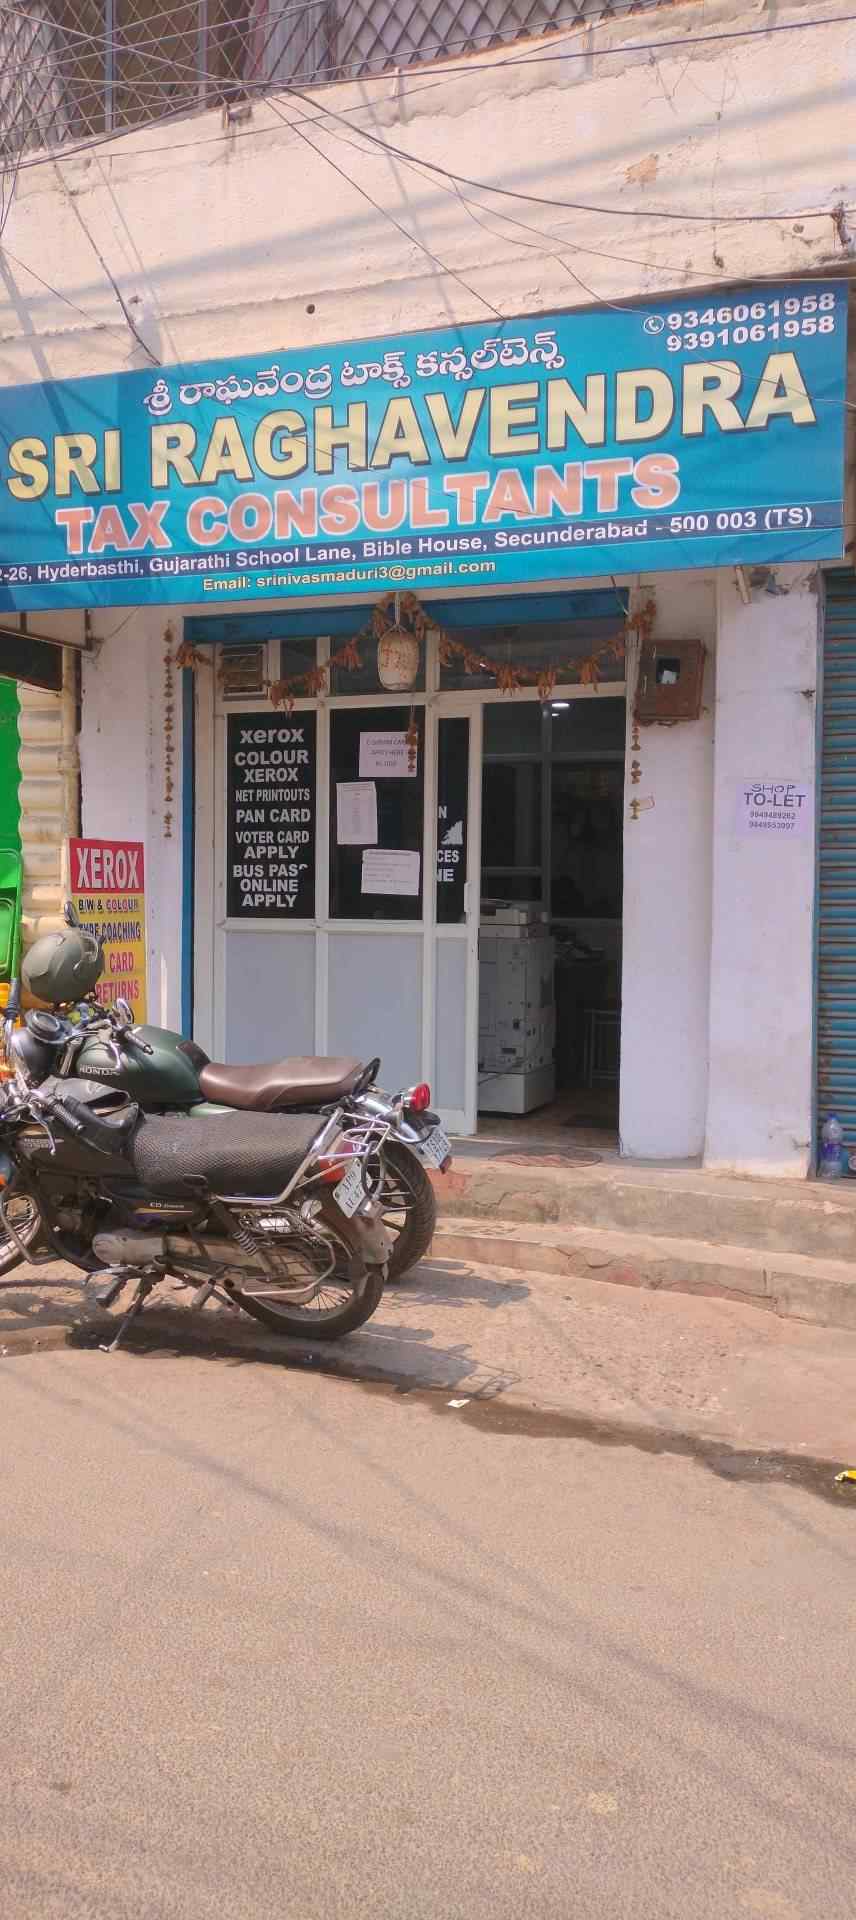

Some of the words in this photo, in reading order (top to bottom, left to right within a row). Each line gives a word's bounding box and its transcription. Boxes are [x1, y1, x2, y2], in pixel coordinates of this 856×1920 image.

[666, 293, 835, 330] 9346061958
[666, 316, 835, 351] 9391061958
[144, 379, 172, 416] శ్రీ
[180, 364, 333, 405] రాఘవేంద్ర
[340, 351, 411, 388] టాక్స్
[6, 428, 121, 500] SRI
[150, 351, 817, 488] RAGHAVENDRA
[55, 500, 172, 555] TAX
[186, 453, 681, 546] CONSULTANTS
[37, 560, 143, 581] Hyderbasthi,
[149, 554, 230, 575] Gujarathi
[235, 548, 298, 567] School
[305, 546, 356, 562] Lane,
[363, 540, 412, 557] Bible
[418, 537, 487, 553] House,
[495, 520, 648, 547] Secunderabad
[670, 516, 709, 533] 500
[716, 511, 756, 530] 003
[765, 507, 812, 529] (TS)
[203, 576, 251, 591] Email:
[256, 561, 496, 588] srinivasmaduri3@gmail.com
[240, 728, 304, 744] xerox
[234, 750, 309, 766] COLOUR
[243, 767, 298, 783] XEROX
[235, 789, 254, 802] NET
[256, 788, 310, 802] PRINTOUTS
[752, 783, 796, 795] SHOP
[744, 792, 806, 807] TO-LET
[236, 809, 265, 823] PAN
[269, 808, 311, 823] CARD
[235, 831, 274, 844] VOTER
[277, 831, 310, 844] CARD
[243, 846, 299, 859] APPLY
[76, 847, 140, 889] XEROX
[233, 865, 264, 878] BUS
[240, 879, 298, 892] ONLINE
[242, 894, 297, 908] APPLY
[101, 921, 141, 941] COACHING
[109, 951, 134, 972] CARD
[96, 979, 139, 1003] RETURNS
